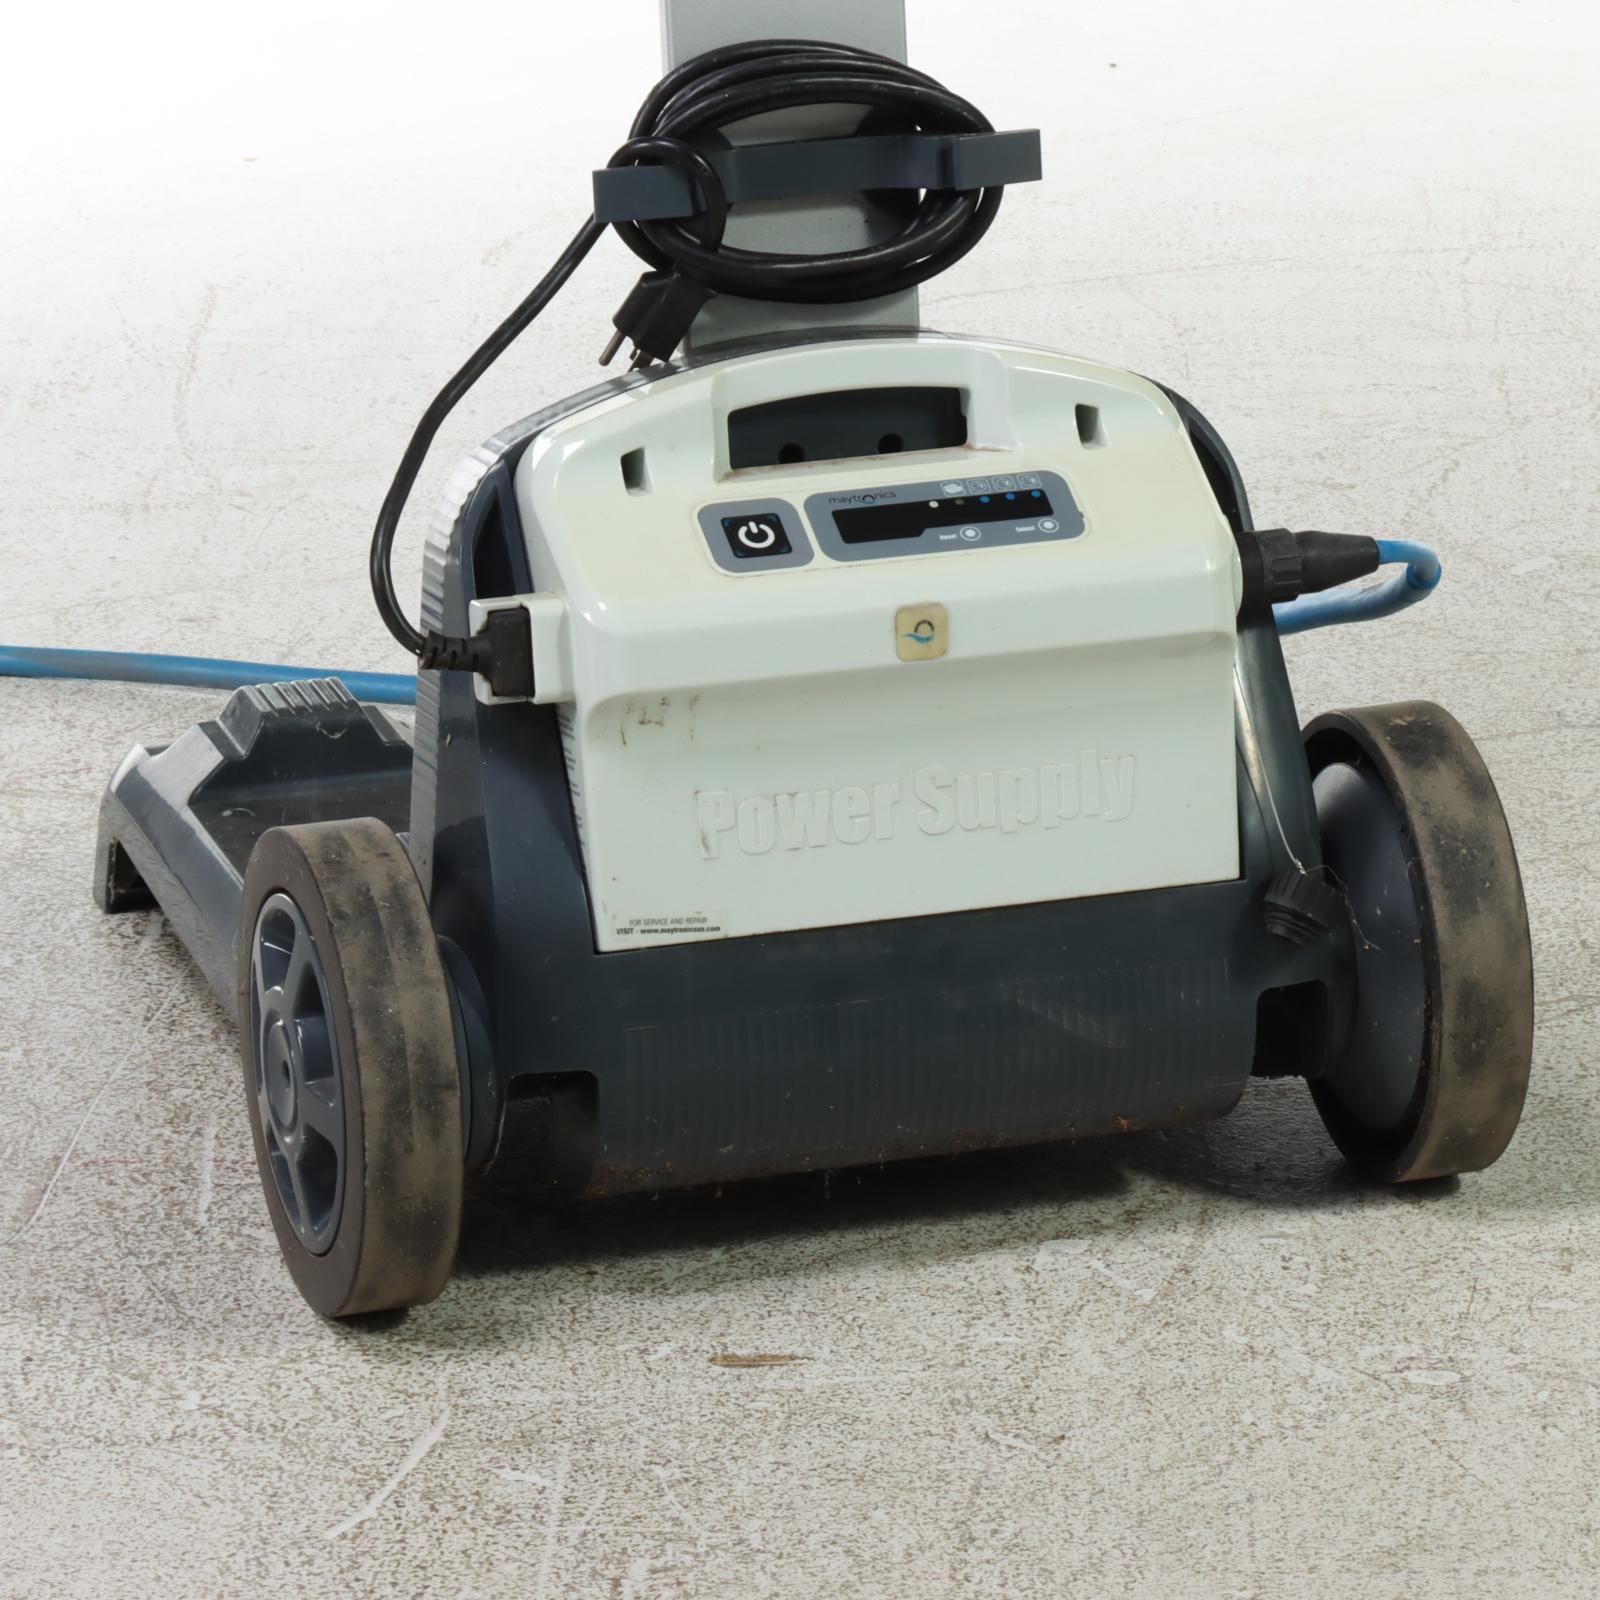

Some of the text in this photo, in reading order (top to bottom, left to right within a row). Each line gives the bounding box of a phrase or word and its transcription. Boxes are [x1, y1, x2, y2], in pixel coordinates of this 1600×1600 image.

[828, 490, 896, 504] maytronics
[695, 749, 1136, 861] Power Supply
[629, 916, 707, 927] FOR SERVICE AND REPAIR
[616, 927, 634, 936] VISIT
